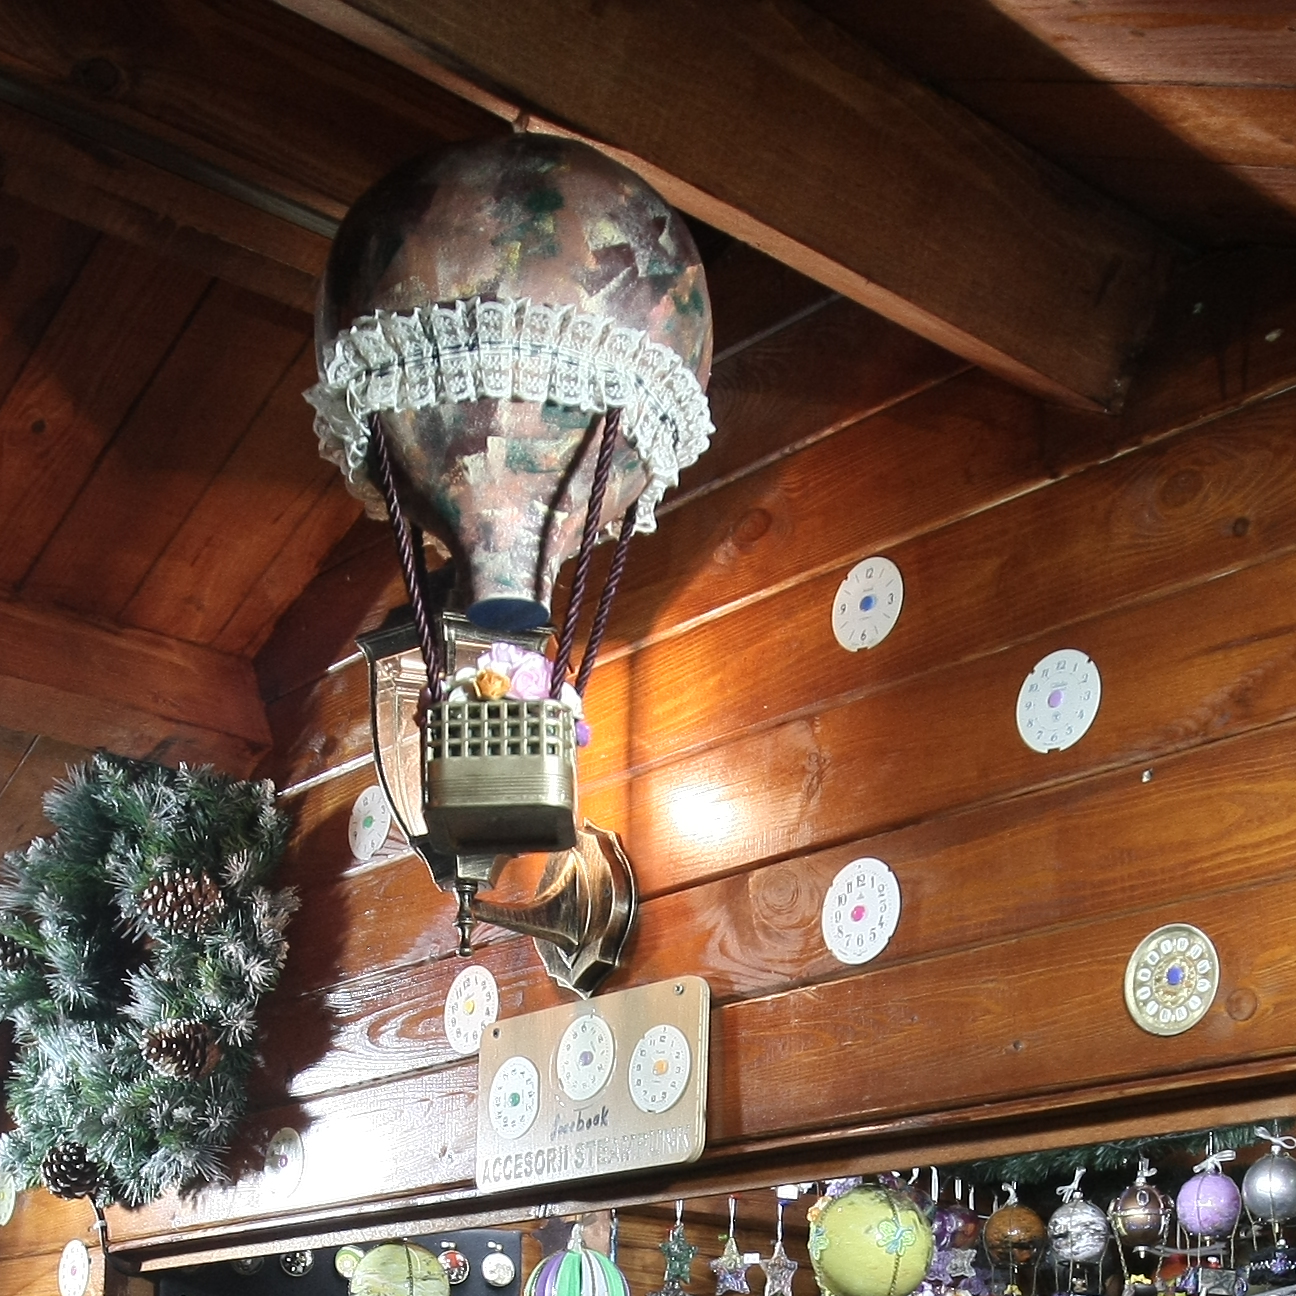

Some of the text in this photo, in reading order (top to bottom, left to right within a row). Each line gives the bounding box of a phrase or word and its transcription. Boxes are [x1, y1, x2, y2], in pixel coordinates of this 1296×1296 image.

[888, 592, 894, 605] 3
[840, 603, 847, 615] 9
[860, 629, 867, 641] 6
[847, 881, 853, 894] 11
[856, 873, 866, 888] 12
[871, 875, 874, 889] 1
[877, 883, 885, 898] 2
[838, 893, 847, 907] 10
[879, 899, 887, 913] 3
[878, 915, 884, 929] 4
[837, 925, 844, 938] 8
[869, 927, 876, 941] 5
[845, 934, 852, 947] 7
[856, 933, 864, 947] 6
[482, 1145, 569, 1184] ACCESORII
